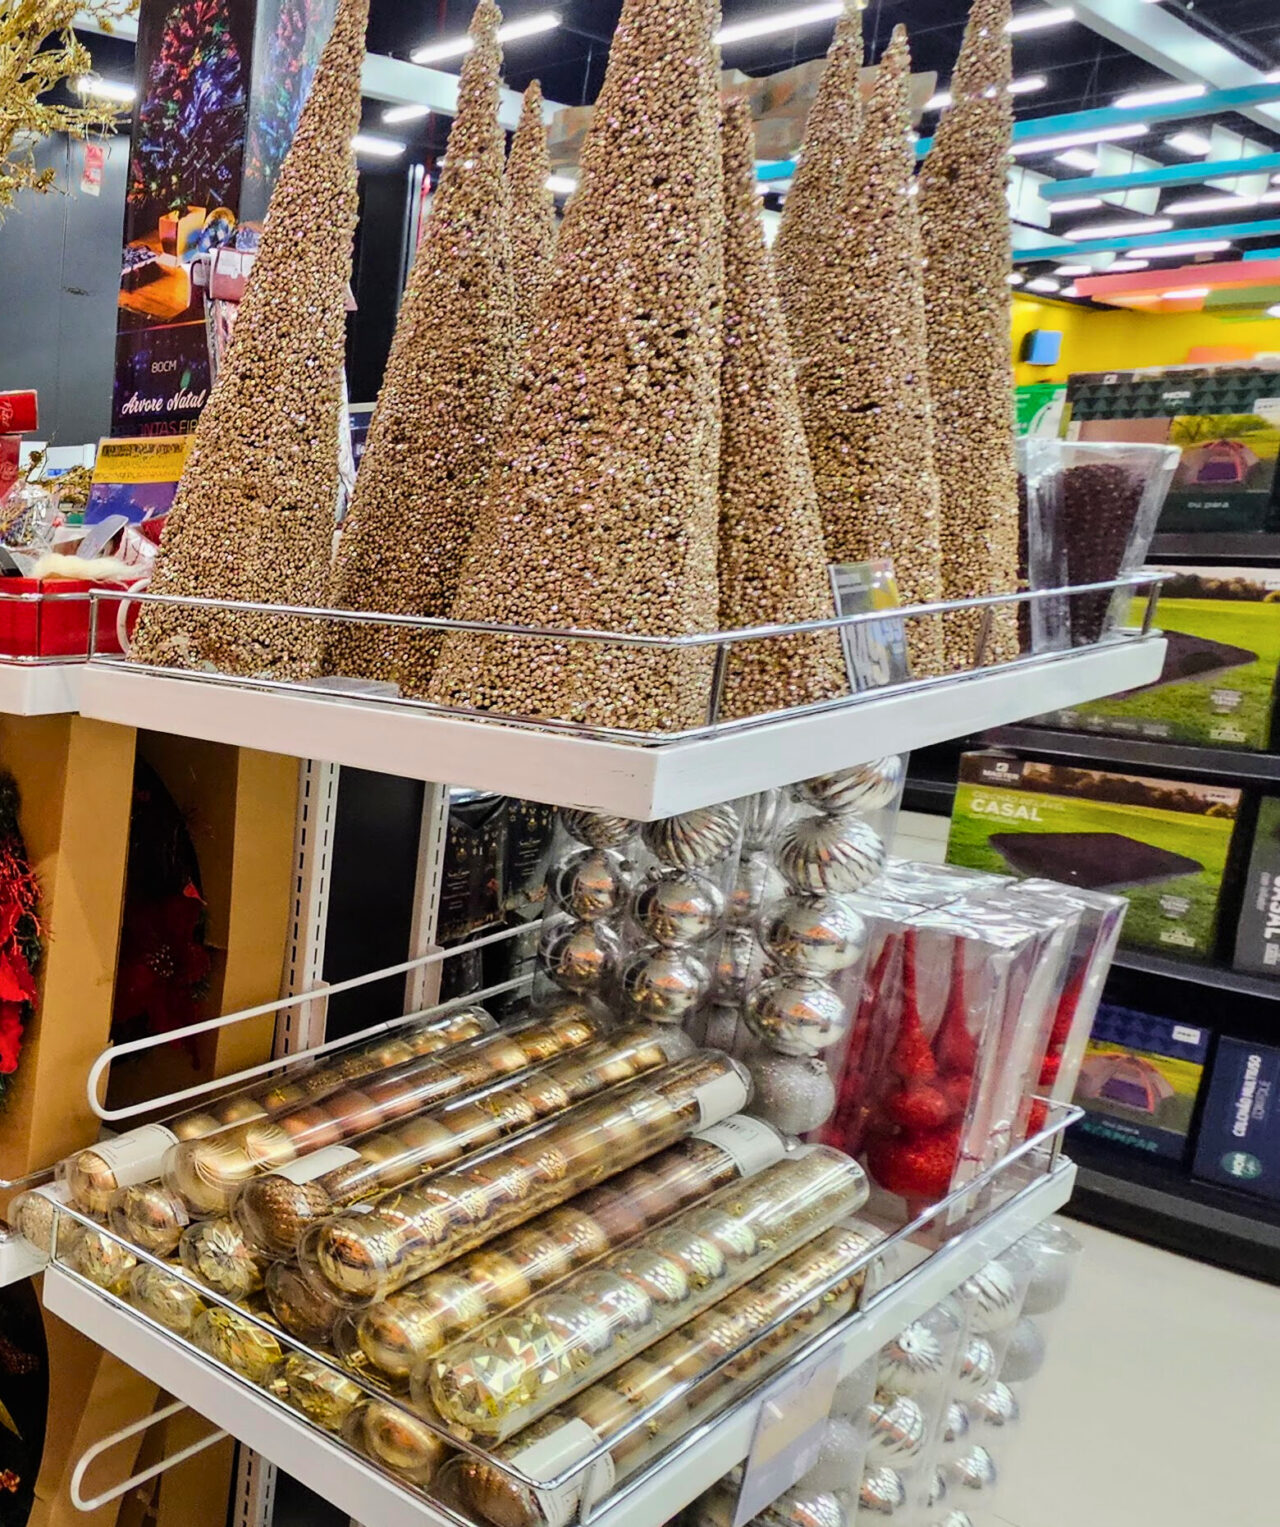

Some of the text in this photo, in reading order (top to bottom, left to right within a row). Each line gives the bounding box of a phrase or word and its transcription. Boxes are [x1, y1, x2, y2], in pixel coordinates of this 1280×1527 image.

[151, 360, 177, 374] 80CM
[166, 388, 207, 411] Natal
[971, 798, 1043, 822] CASAL
